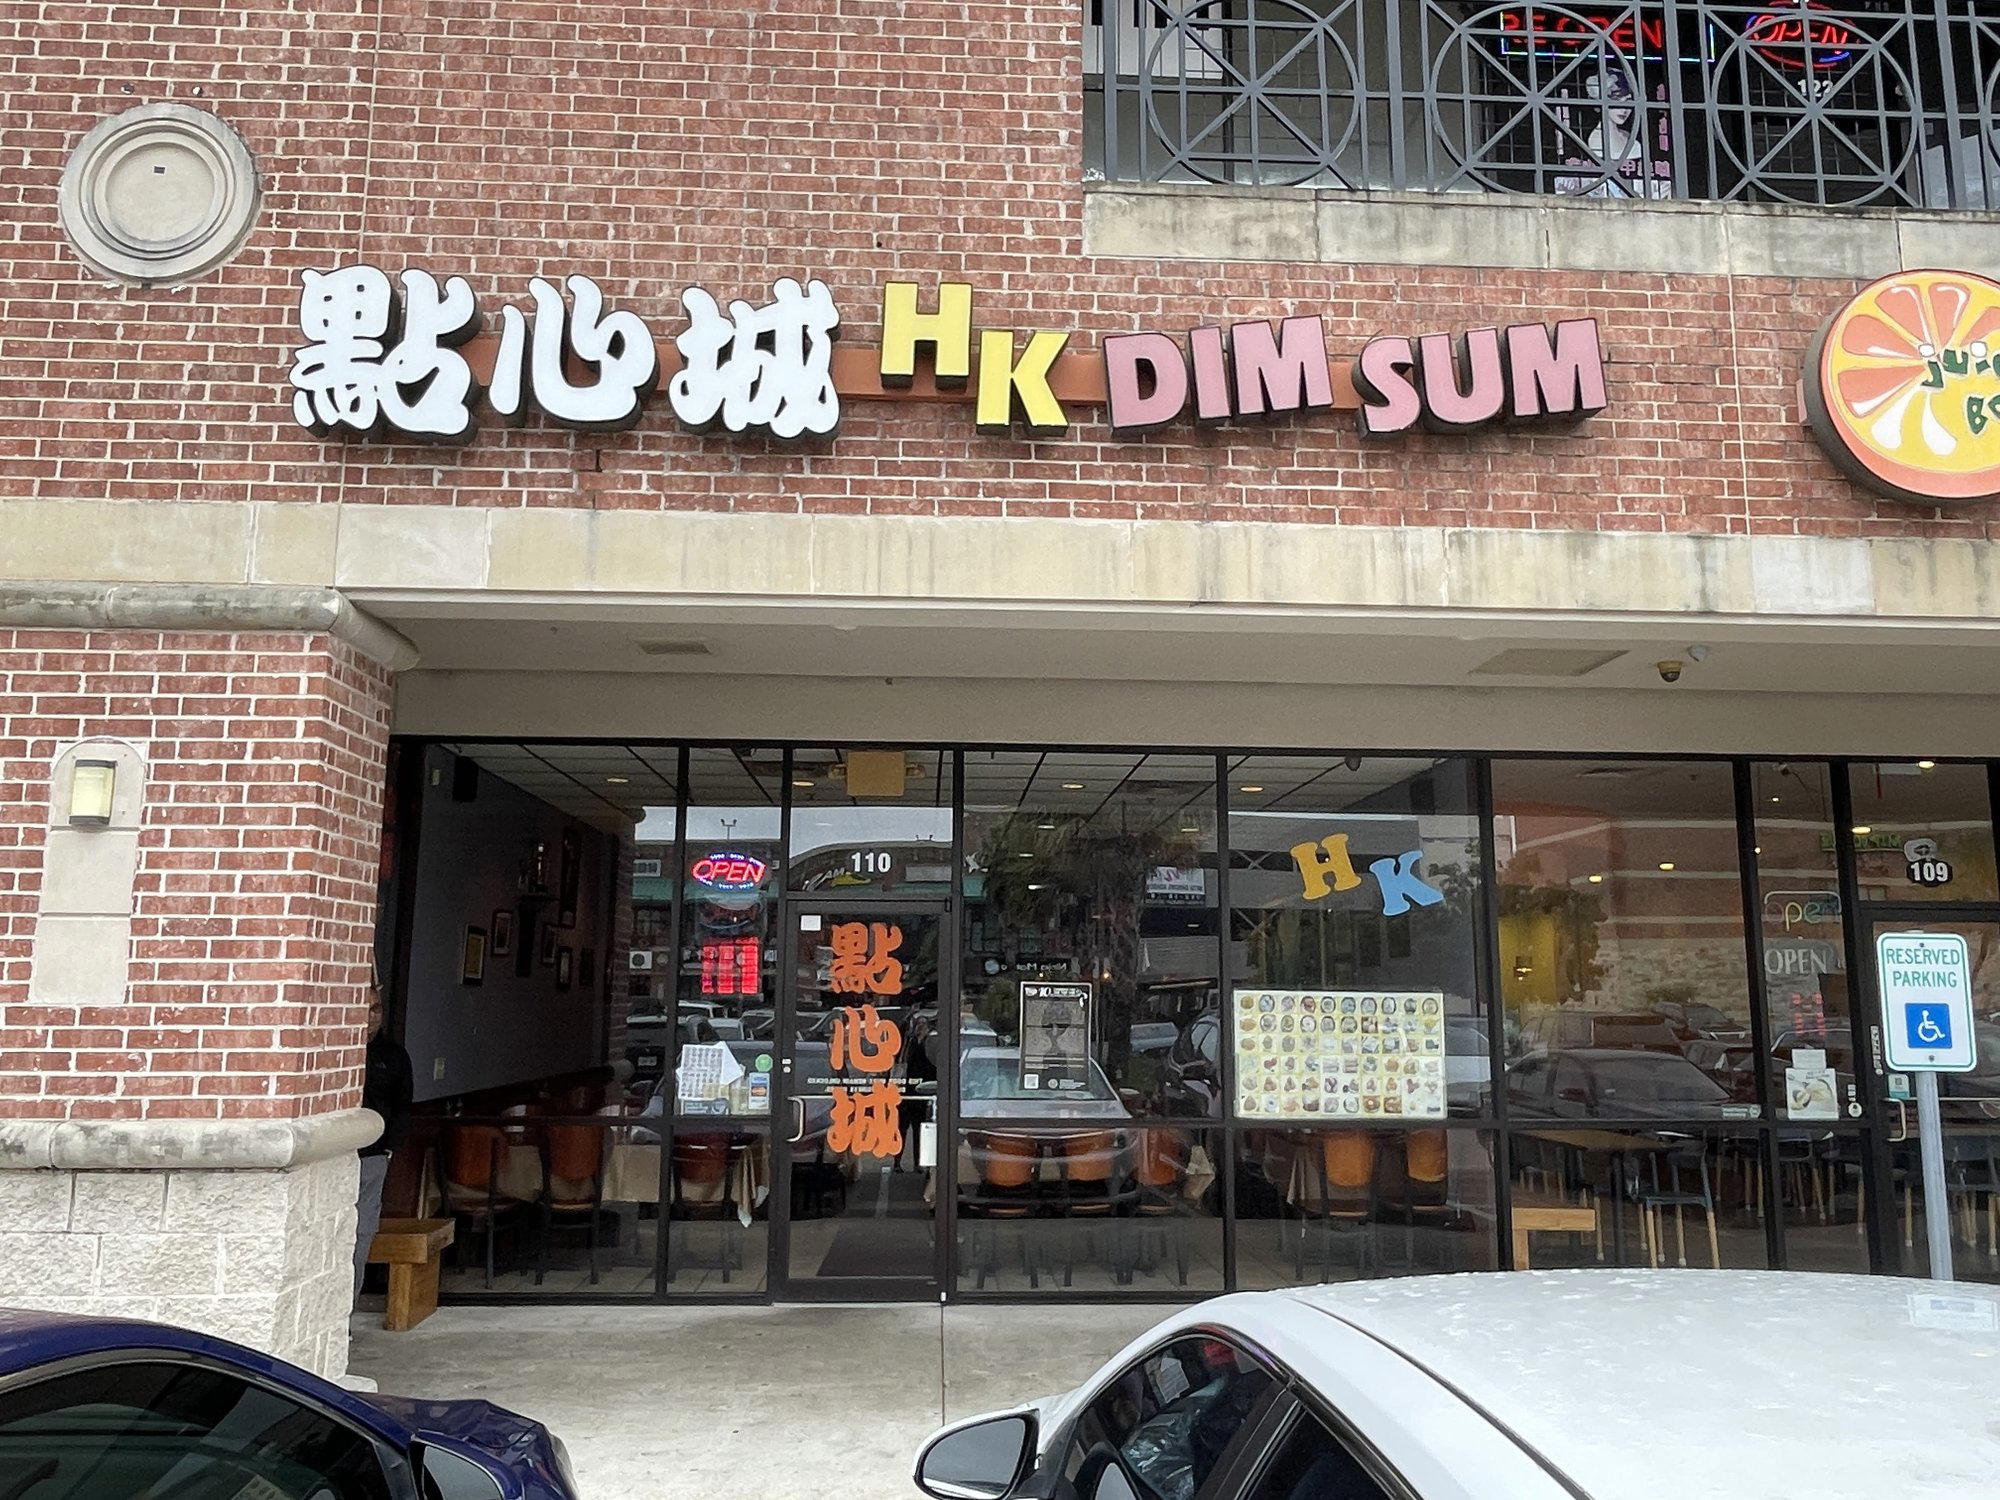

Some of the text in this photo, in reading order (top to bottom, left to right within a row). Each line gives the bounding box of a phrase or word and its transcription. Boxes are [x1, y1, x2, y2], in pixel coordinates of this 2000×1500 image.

[1750, 15, 1849, 54] OPN
[1102, 314, 1334, 430] DIM
[1359, 317, 1607, 433] SUM
[692, 860, 766, 883] OPEN
[851, 851, 892, 873] 110
[1910, 861, 1949, 882] 109
[1765, 901, 1839, 931] ope
[1764, 948, 1828, 975] OPEN
[1886, 948, 1961, 966] RESERVED
[1893, 970, 1958, 988] PARKING
